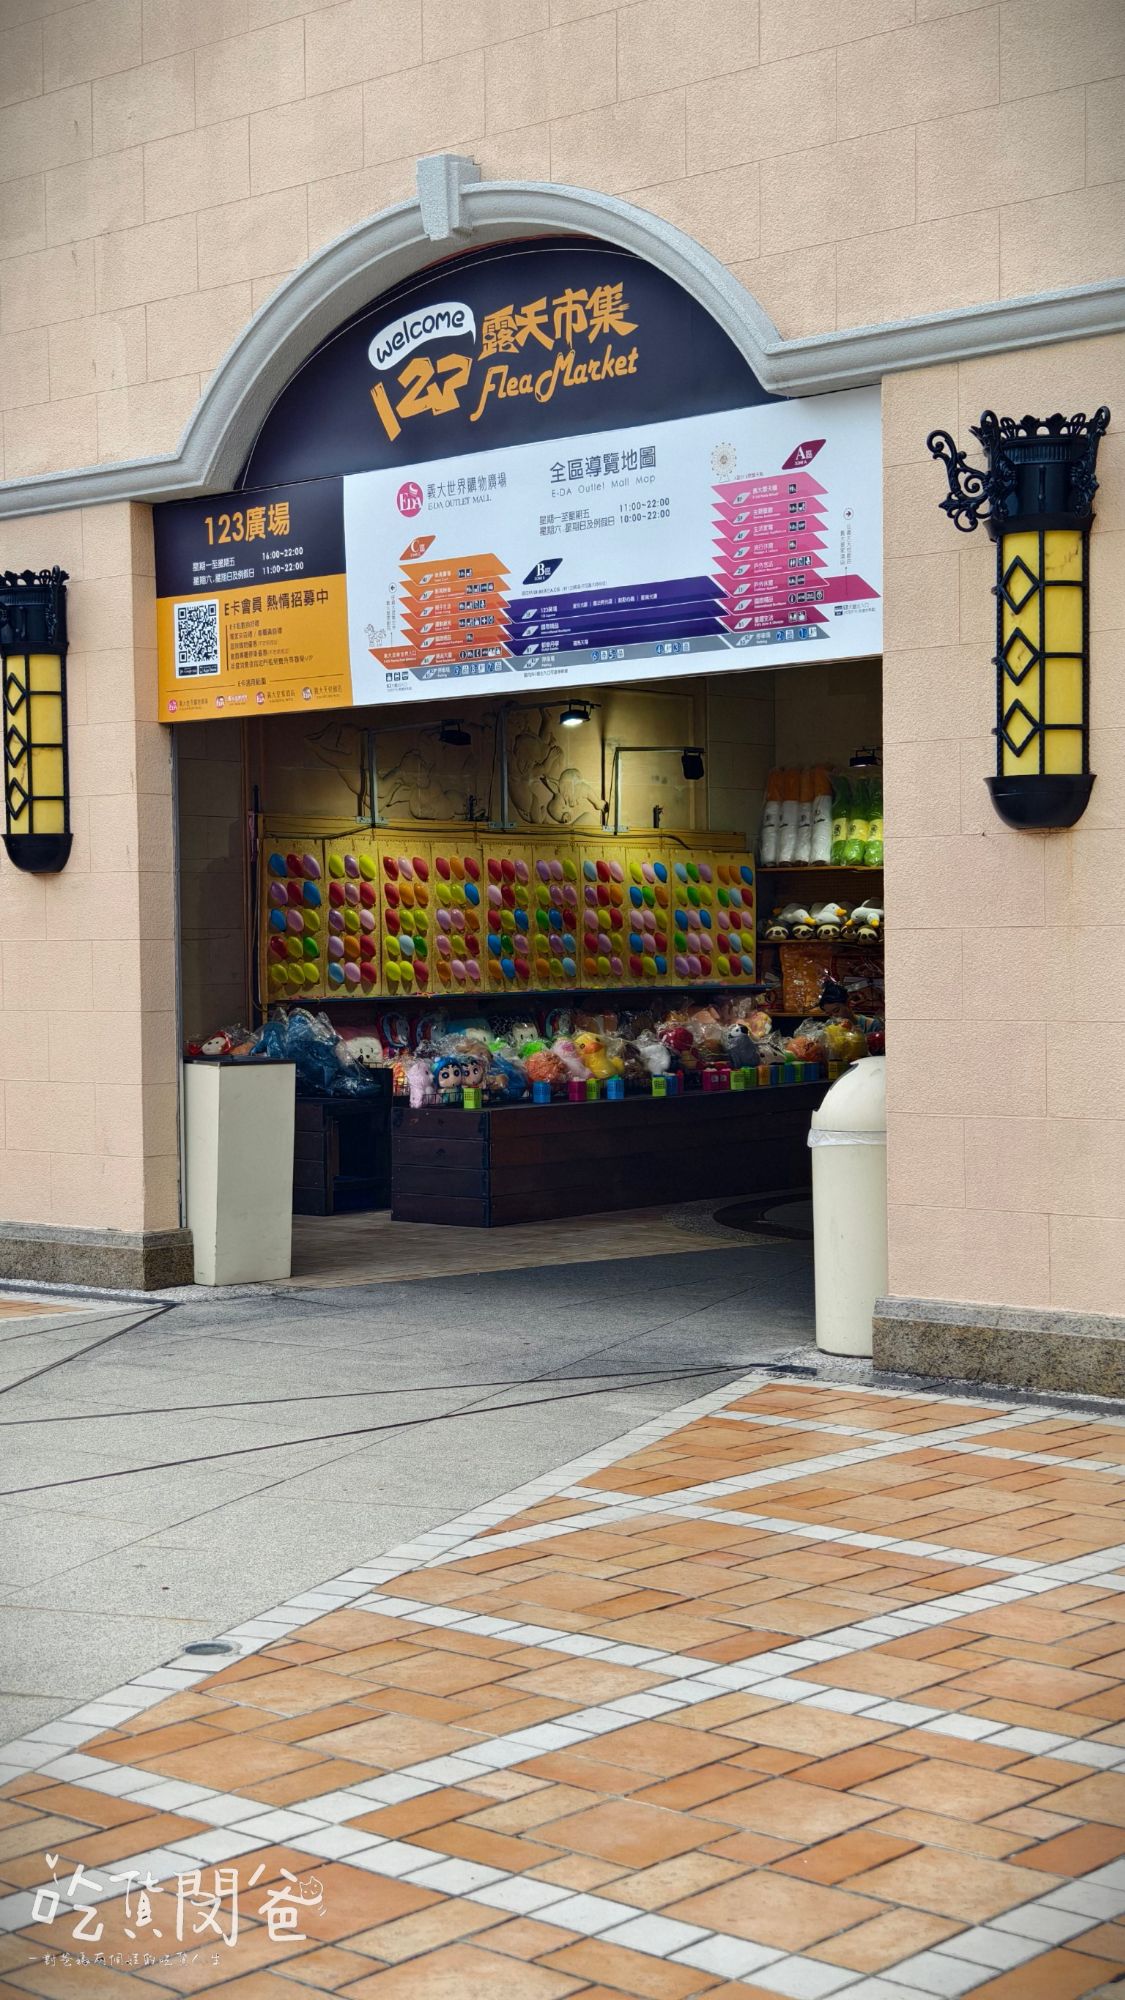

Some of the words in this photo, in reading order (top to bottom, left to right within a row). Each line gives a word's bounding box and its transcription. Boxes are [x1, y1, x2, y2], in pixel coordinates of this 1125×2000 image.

[478, 281, 639, 361] 露天市集
[376, 309, 466, 364] welcome
[470, 364, 534, 422] Flea
[534, 344, 639, 403] Market
[370, 353, 473, 442] 123
[549, 445, 657, 484] 全區導覽地圖
[427, 472, 507, 500] 義大世界購物廣場
[551, 487, 573, 498] E-DA
[577, 481, 606, 494] Outlet
[611, 477, 630, 489] Mall
[635, 474, 656, 485] Map
[619, 497, 671, 513] 11:00~22:00
[619, 508, 671, 524] 10:00~22:00
[204, 501, 291, 545] 123廣場
[262, 546, 304, 561] 16:00~22:00
[262, 561, 304, 575] 11:00~22:00
[224, 597, 263, 616] E卡會員
[266, 588, 330, 612] 熱情招募中
